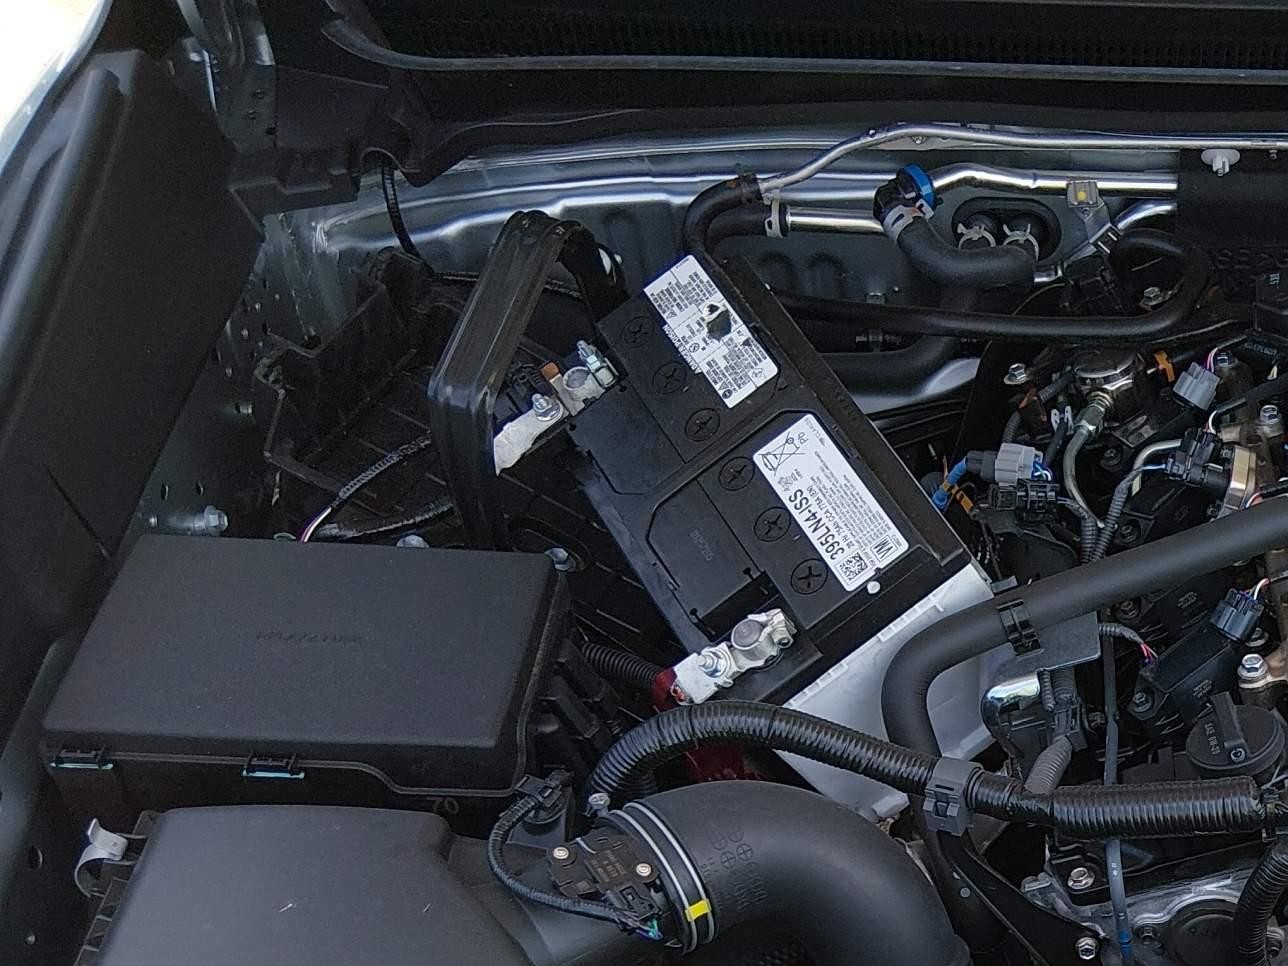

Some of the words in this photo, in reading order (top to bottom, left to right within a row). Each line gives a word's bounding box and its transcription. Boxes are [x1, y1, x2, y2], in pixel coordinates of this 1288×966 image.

[796, 431, 809, 445] Pb
[787, 487, 846, 562] 395LN4-ISS
[823, 508, 836, 523] CCA
[873, 538, 895, 559] VM
